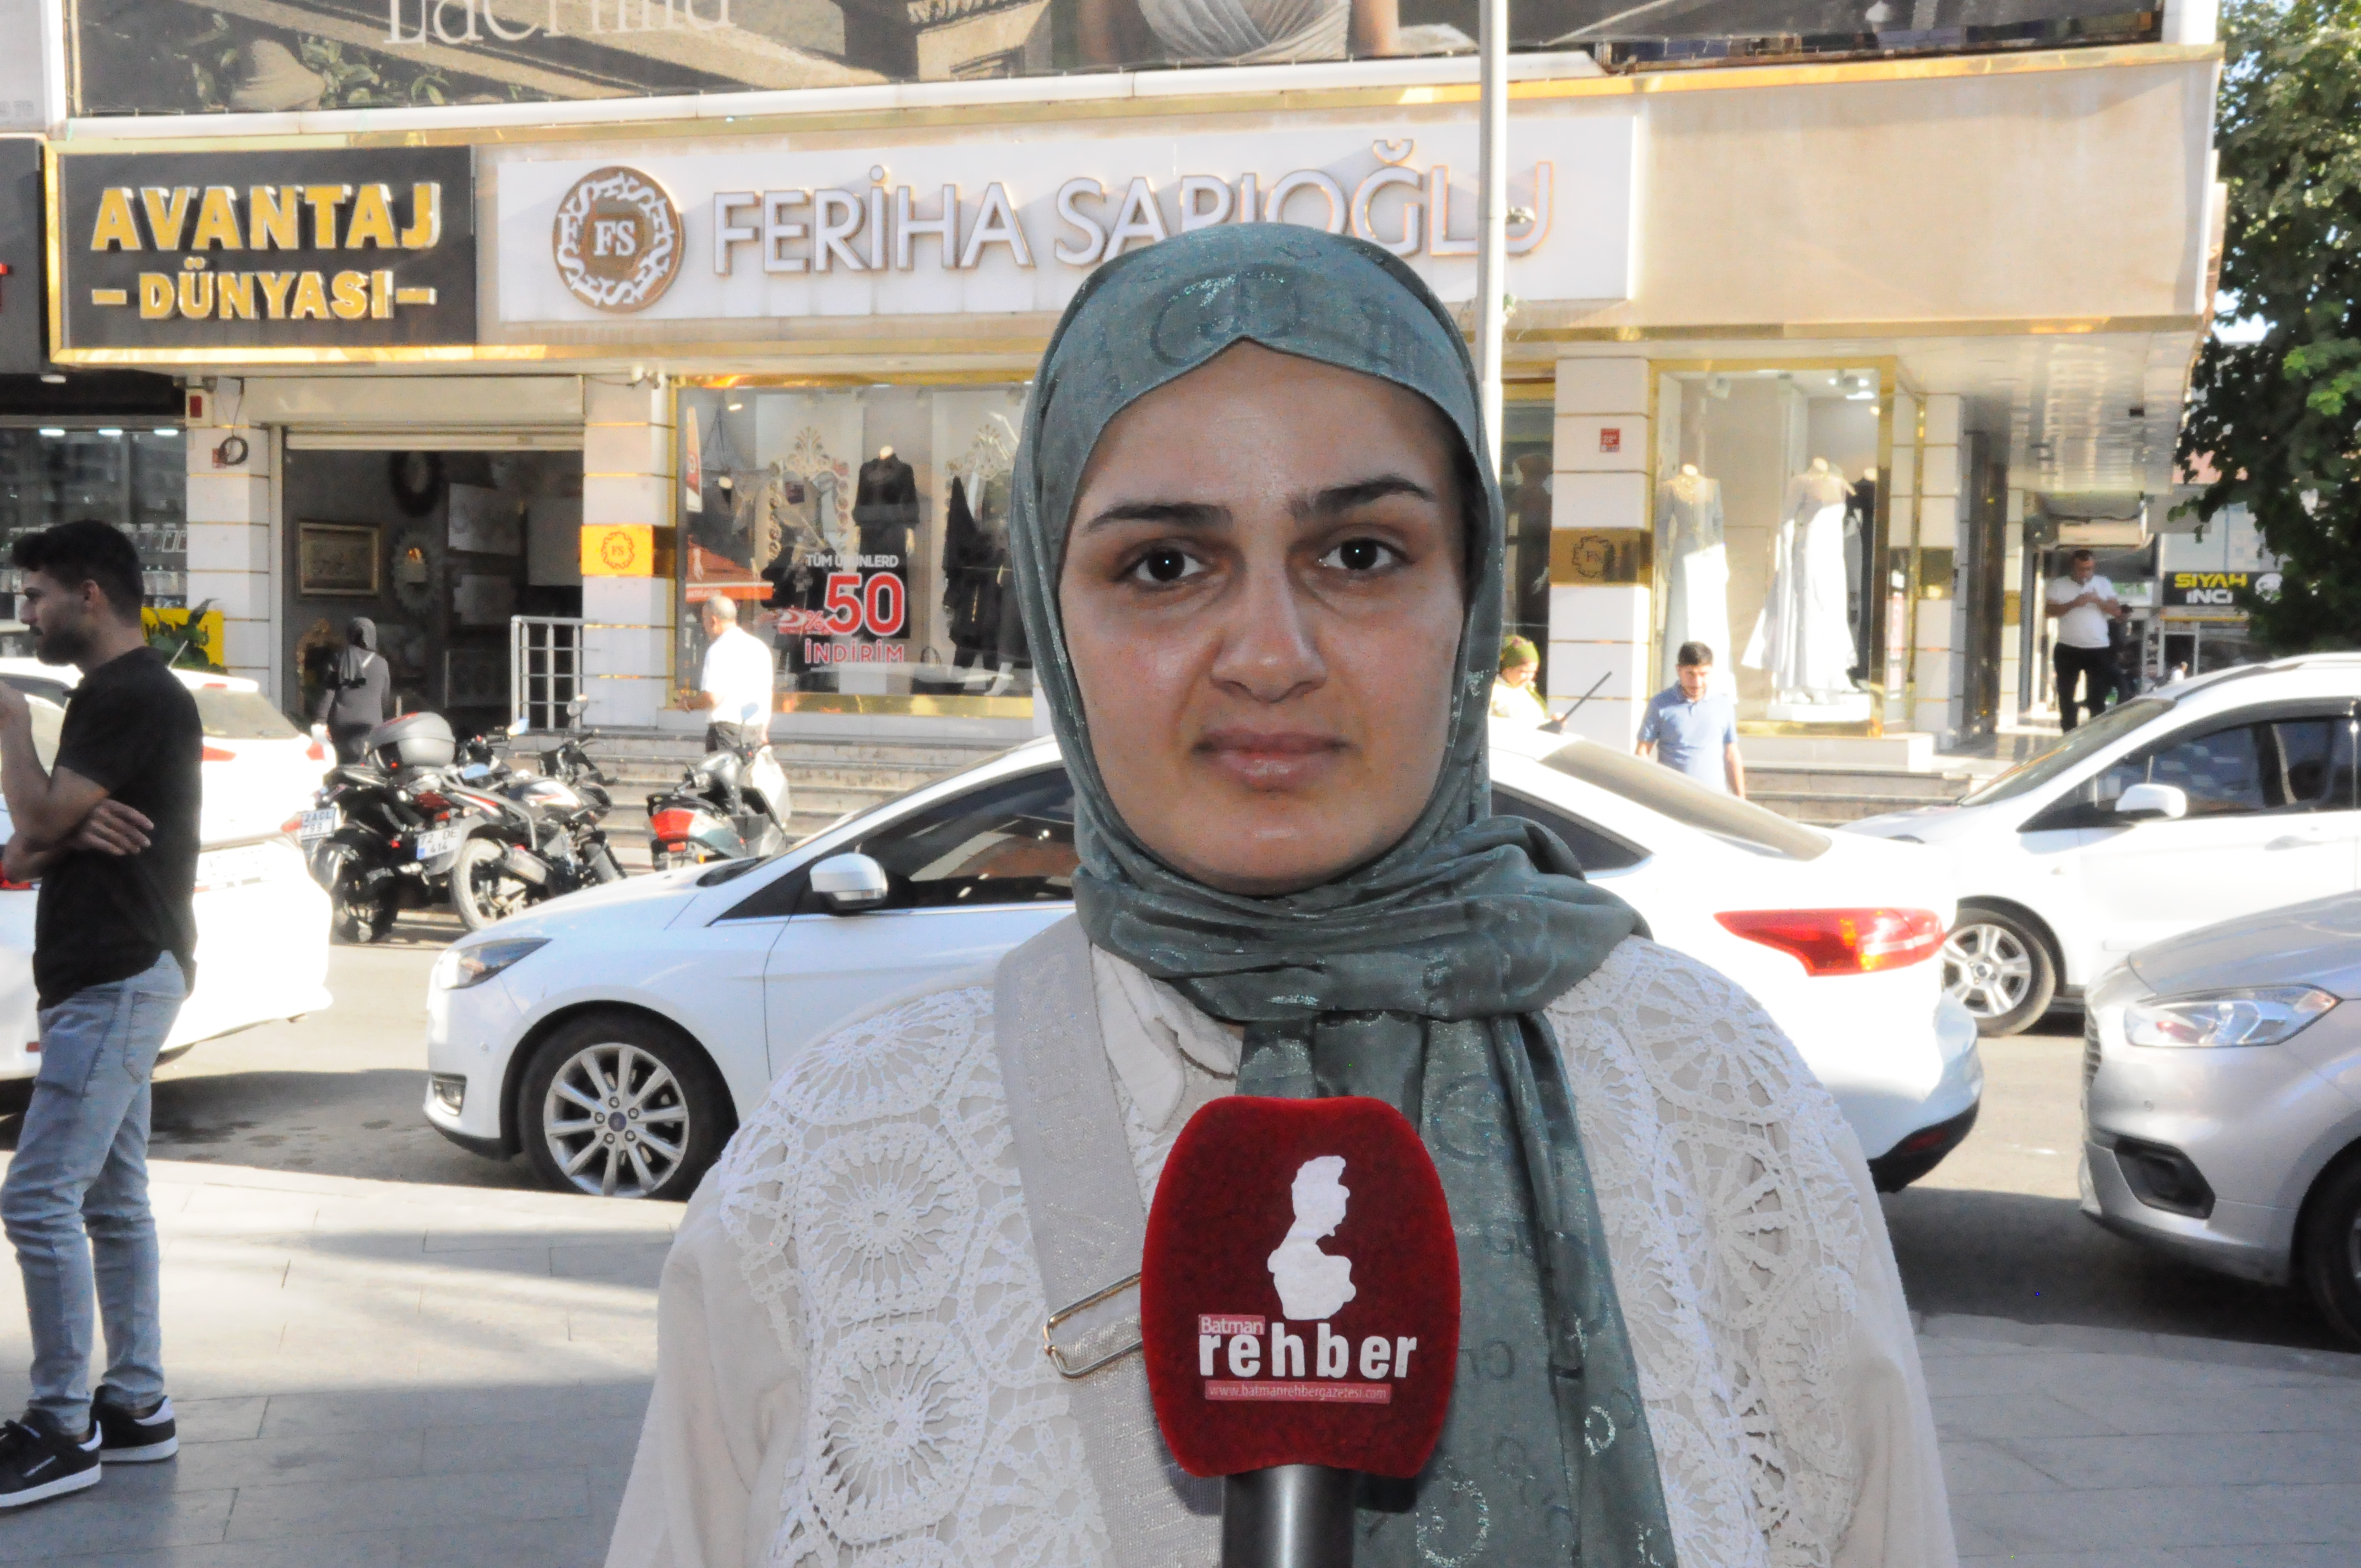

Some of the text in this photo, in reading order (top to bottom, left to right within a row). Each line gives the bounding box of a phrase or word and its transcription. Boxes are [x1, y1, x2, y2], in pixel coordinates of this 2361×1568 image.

[91, 182, 442, 251] AVANTAJ
[714, 165, 1033, 275] FERİHA
[594, 221, 636, 256] FS
[611, 545, 624, 556] FS
[806, 552, 832, 568] TÜM
[804, 638, 905, 663] İNDİRİM
[419, 827, 458, 845] 72 DE
[1200, 1316, 1264, 1335] Batman
[1199, 1322, 1417, 1379] rehber
[1209, 1384, 1387, 1401] www.batmanrehbergazetesi.com
